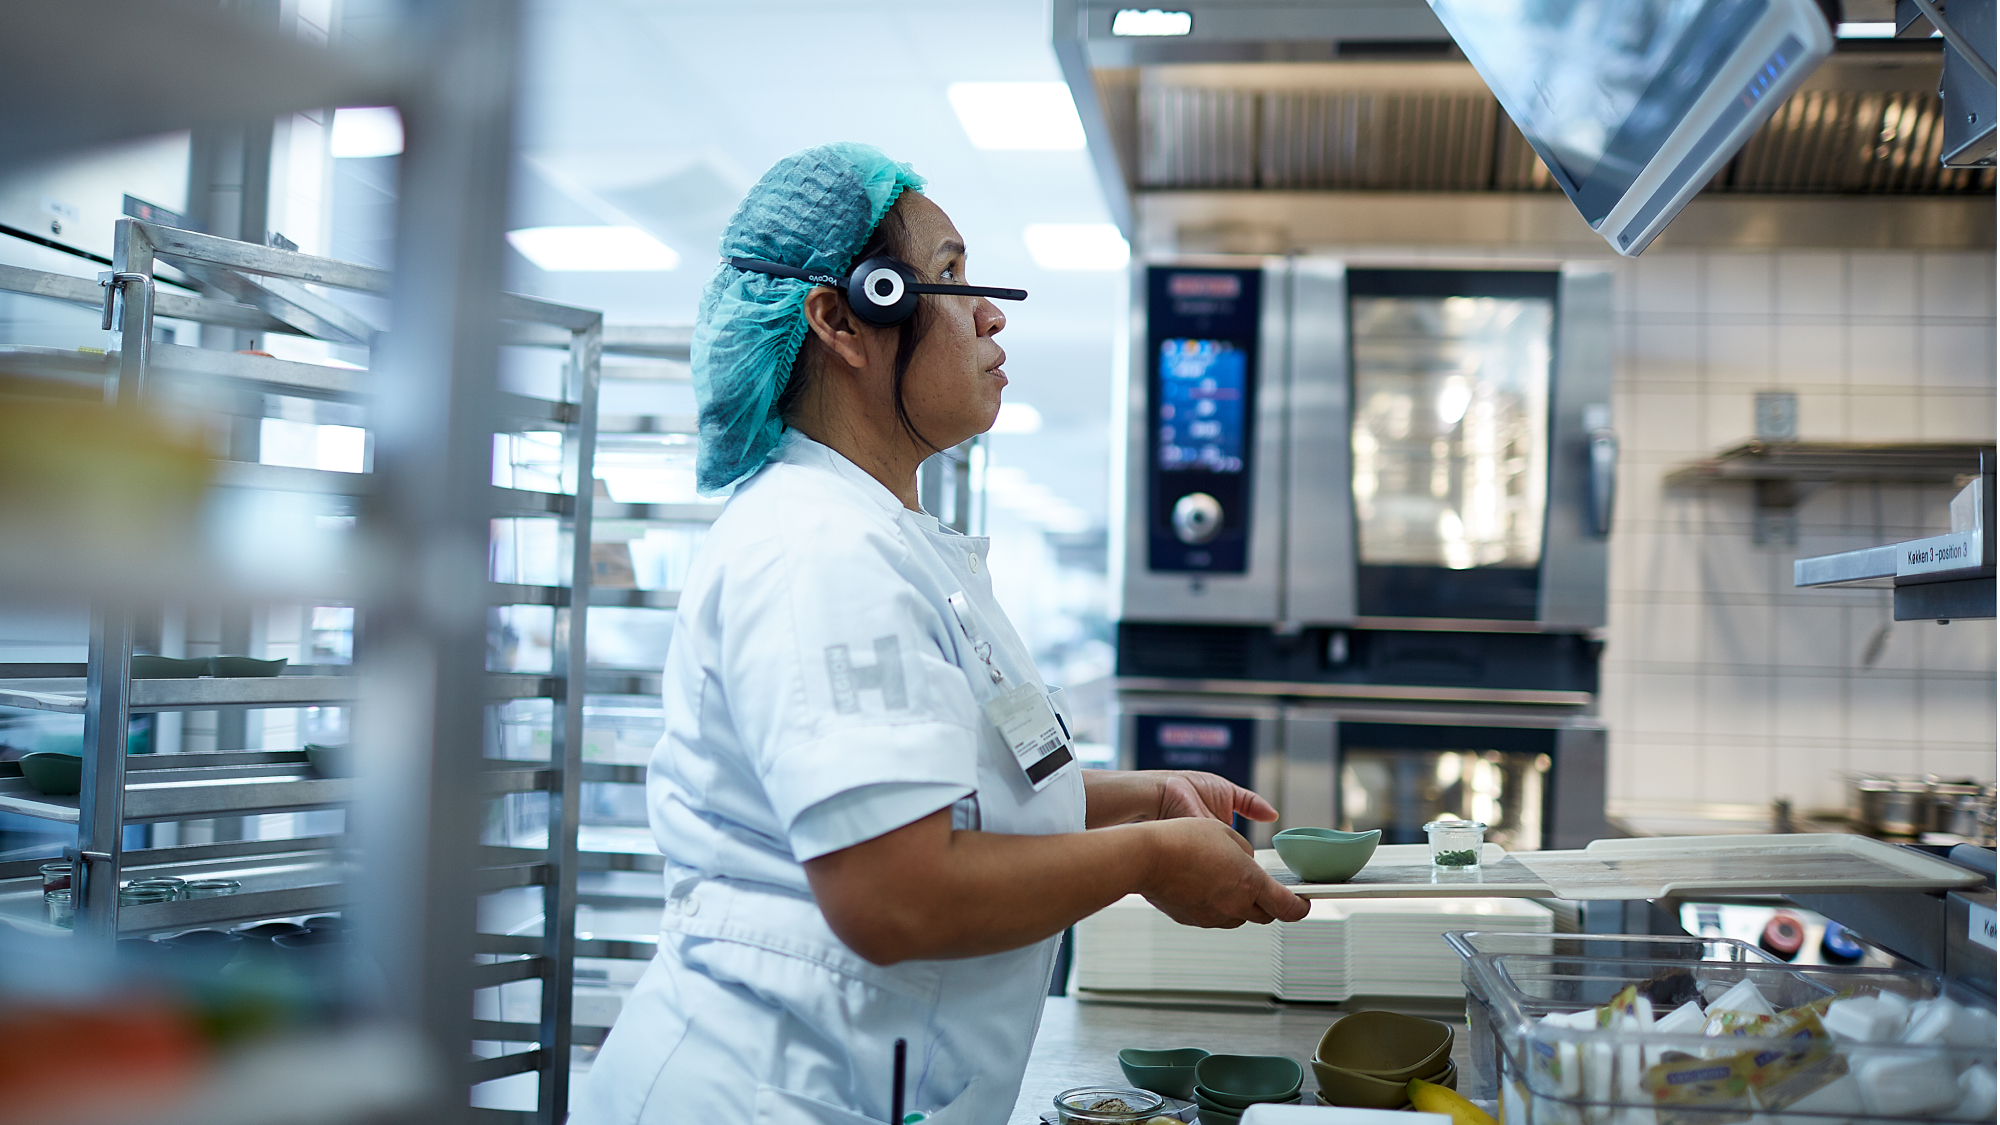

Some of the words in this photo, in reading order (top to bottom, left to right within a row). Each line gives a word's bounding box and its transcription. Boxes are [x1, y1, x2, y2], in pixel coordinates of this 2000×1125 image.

[808, 274, 837, 286] VoCoVo
[1907, 549, 1929, 565] Køkken
[1929, 547, 1934, 562] 3
[1962, 541, 1968, 557] 3
